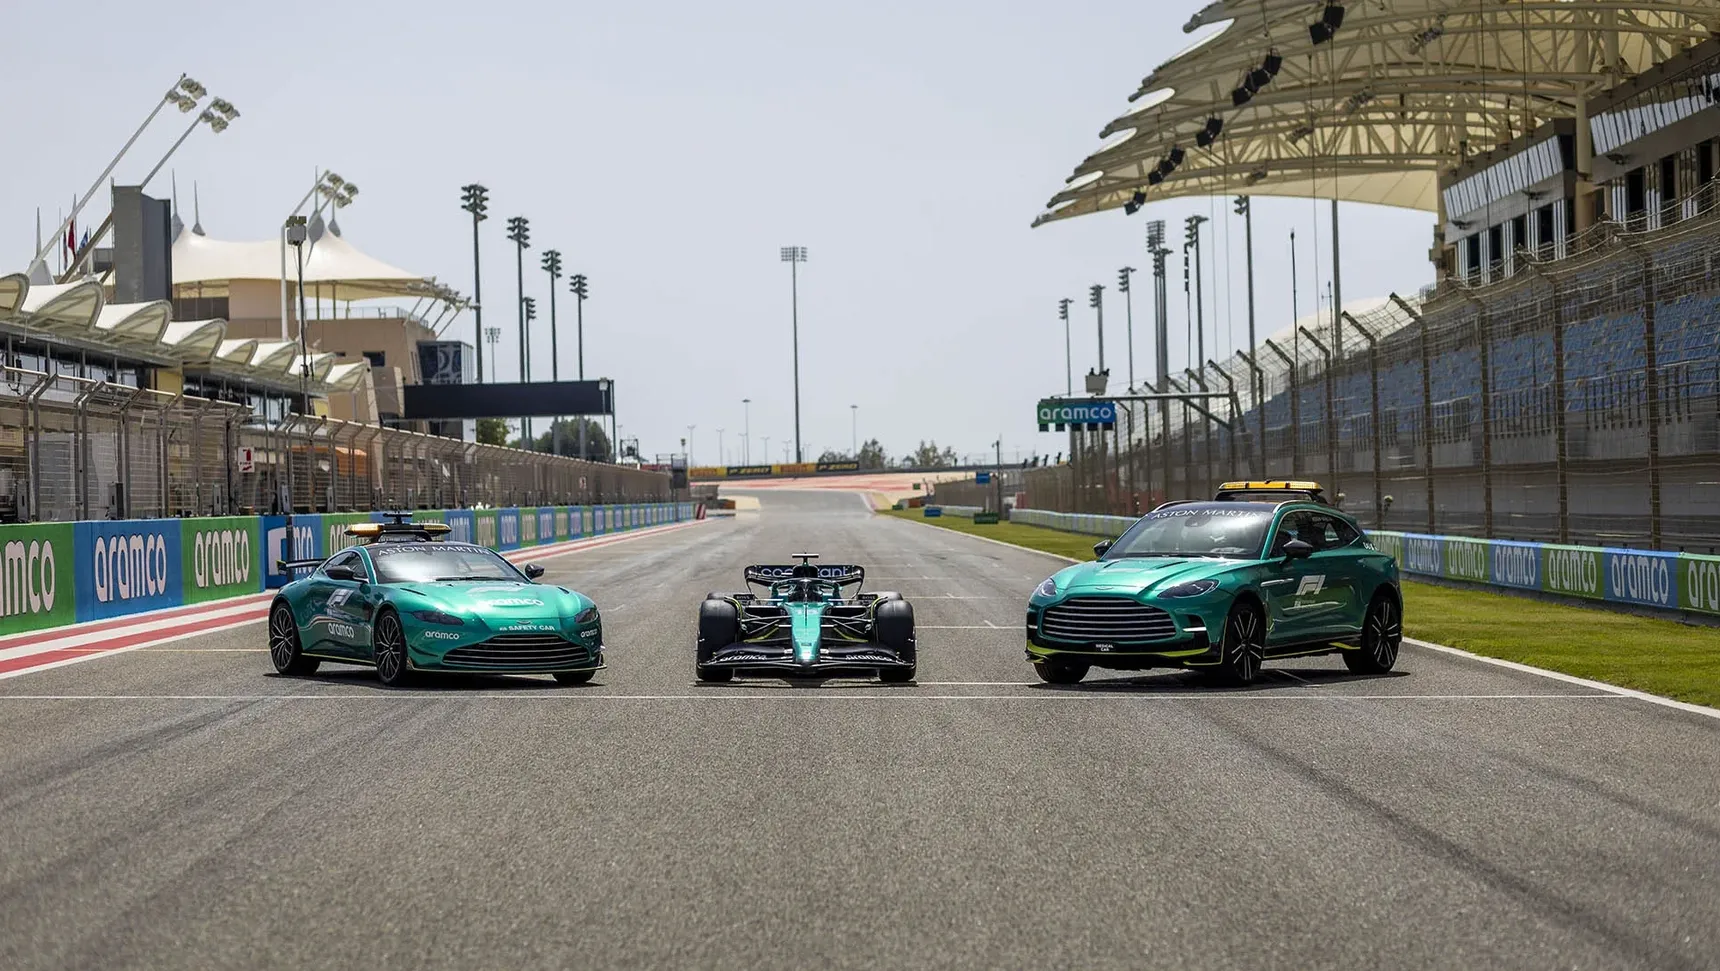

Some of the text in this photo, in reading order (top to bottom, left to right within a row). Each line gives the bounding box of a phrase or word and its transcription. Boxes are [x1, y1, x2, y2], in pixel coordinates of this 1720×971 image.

[1040, 407, 1112, 420] aramco
[1151, 510, 1199, 520] ASTON
[95, 533, 167, 602] aramco
[195, 529, 250, 588] aramco
[379, 546, 490, 556] ASTON MARTIN
[1408, 538, 1440, 573] aramco
[1448, 541, 1485, 579] aramco
[1495, 546, 1537, 586] aramco
[1548, 548, 1597, 593] aramco
[0, 540, 55, 617] mco
[1611, 554, 1669, 604] aramco
[1688, 561, 1720, 610] ara
[328, 623, 355, 638] aramco
[424, 630, 460, 641] aramco
